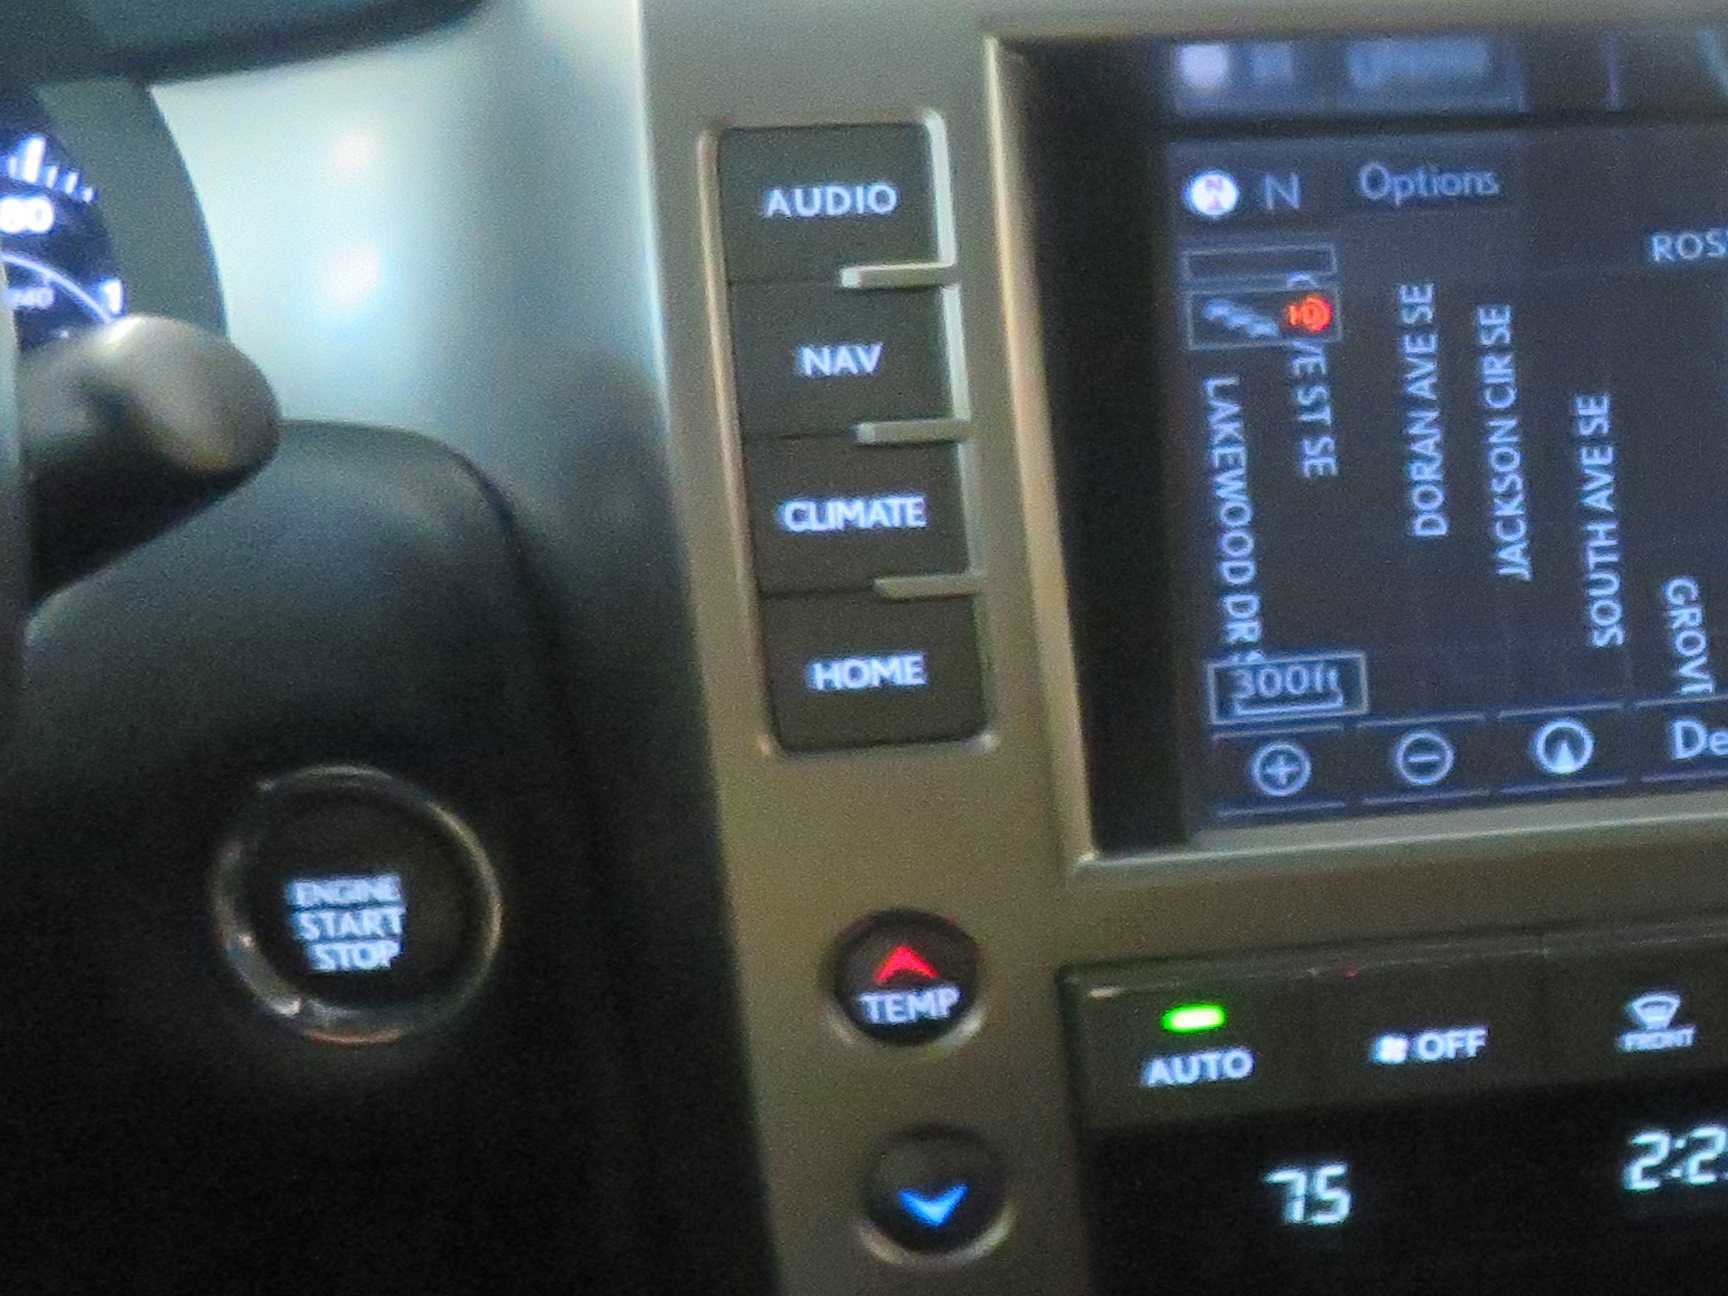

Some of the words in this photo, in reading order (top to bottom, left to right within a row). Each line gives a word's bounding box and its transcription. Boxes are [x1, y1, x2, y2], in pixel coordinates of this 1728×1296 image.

[763, 185, 898, 217] AUDIO
[1262, 173, 1299, 209] N
[1358, 160, 1500, 206] Options
[1400, 282, 1434, 325] SE
[1476, 303, 1512, 347] SE
[800, 345, 884, 377] NAV
[1403, 331, 1438, 400] AVE
[1481, 352, 1517, 409] CIR
[1298, 384, 1333, 425] ST
[1576, 393, 1610, 435] SE
[1302, 436, 1337, 479] SE
[1408, 407, 1448, 537] DORAN
[1580, 445, 1615, 512] AVE
[1204, 375, 1255, 585] LAKEWOOD
[1487, 416, 1533, 582] JACKSON
[780, 495, 927, 532] CLIMATE
[1586, 520, 1624, 647] SOUTH
[1224, 593, 1262, 644] DR
[811, 655, 927, 691] HOME
[294, 906, 408, 941] START
[308, 940, 402, 972] STOP
[858, 988, 962, 1027] TEMP
[1414, 1028, 1488, 1061] OFF
[1143, 1048, 1256, 1088] AUTO
[1266, 1162, 1352, 1226] 75
